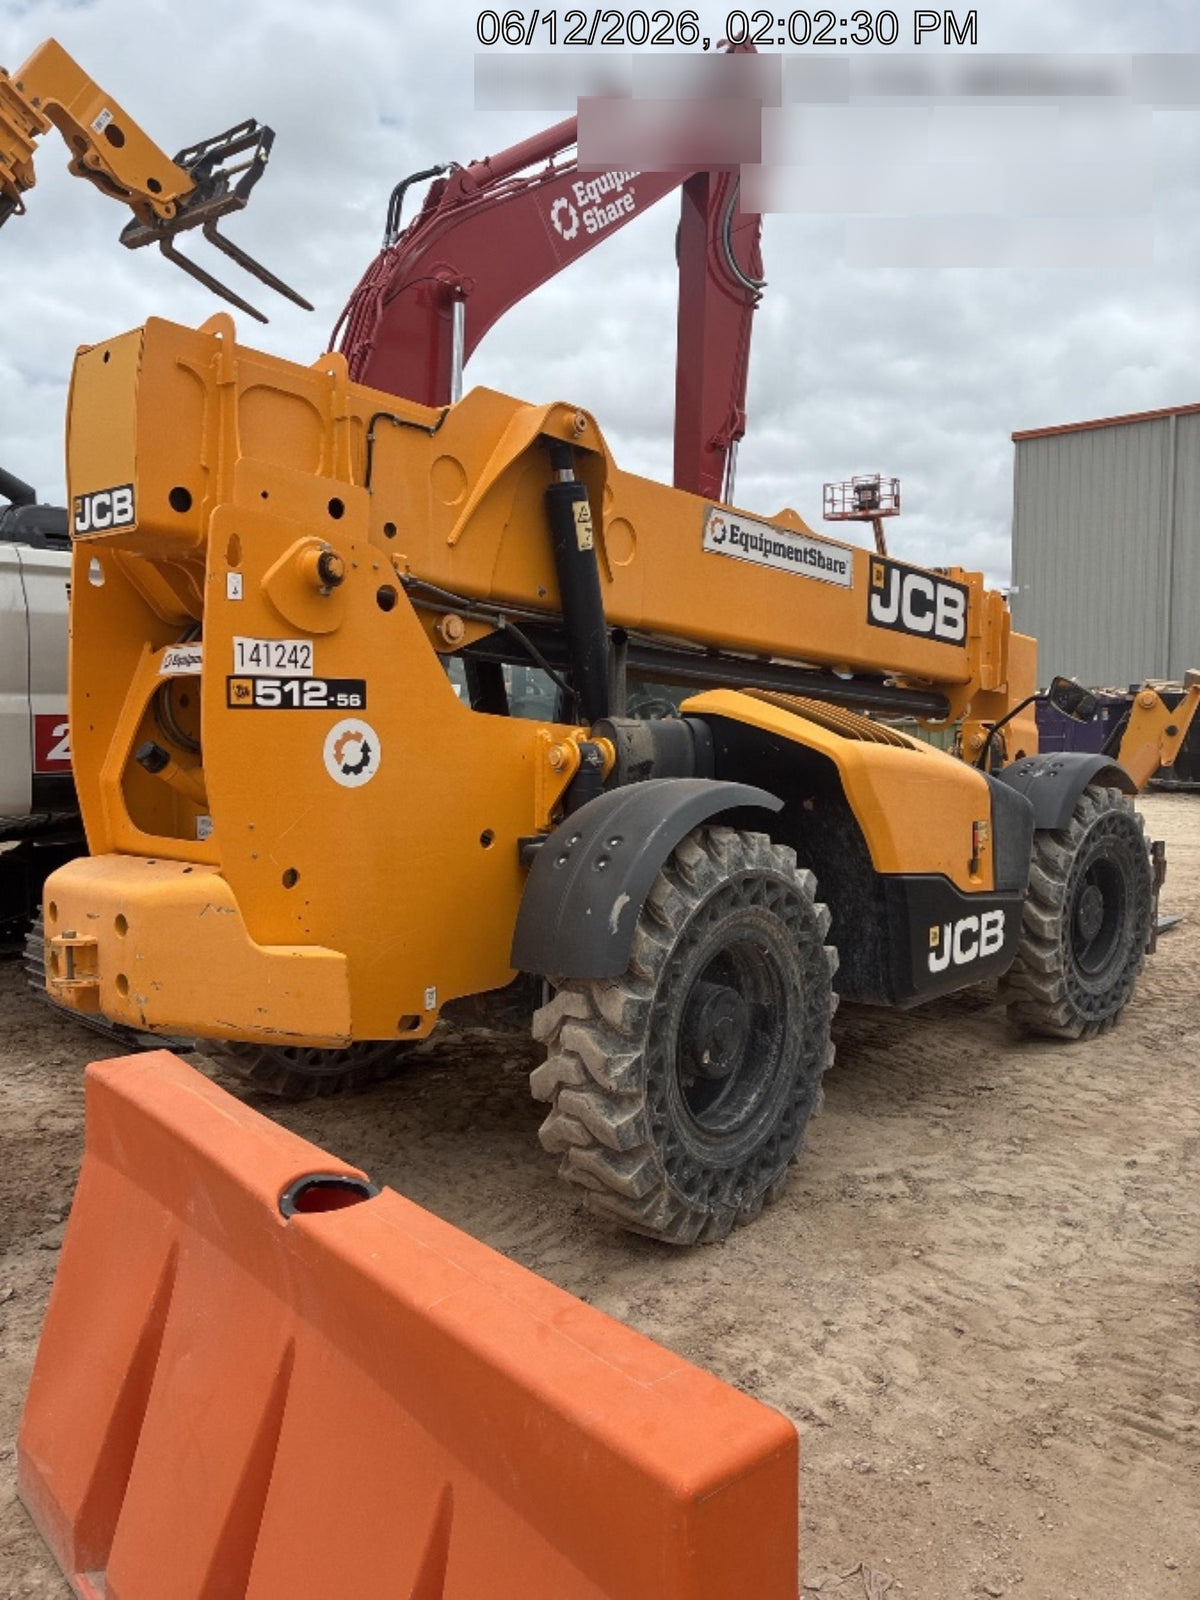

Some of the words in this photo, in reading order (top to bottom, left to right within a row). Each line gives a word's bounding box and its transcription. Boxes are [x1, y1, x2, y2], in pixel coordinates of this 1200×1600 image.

[582, 193, 635, 234] Share
[76, 488, 134, 532] JCB
[728, 523, 847, 575] EquipmentShare
[870, 567, 967, 641] JCB
[237, 642, 312, 669] 141242
[927, 909, 1006, 973] JCB
